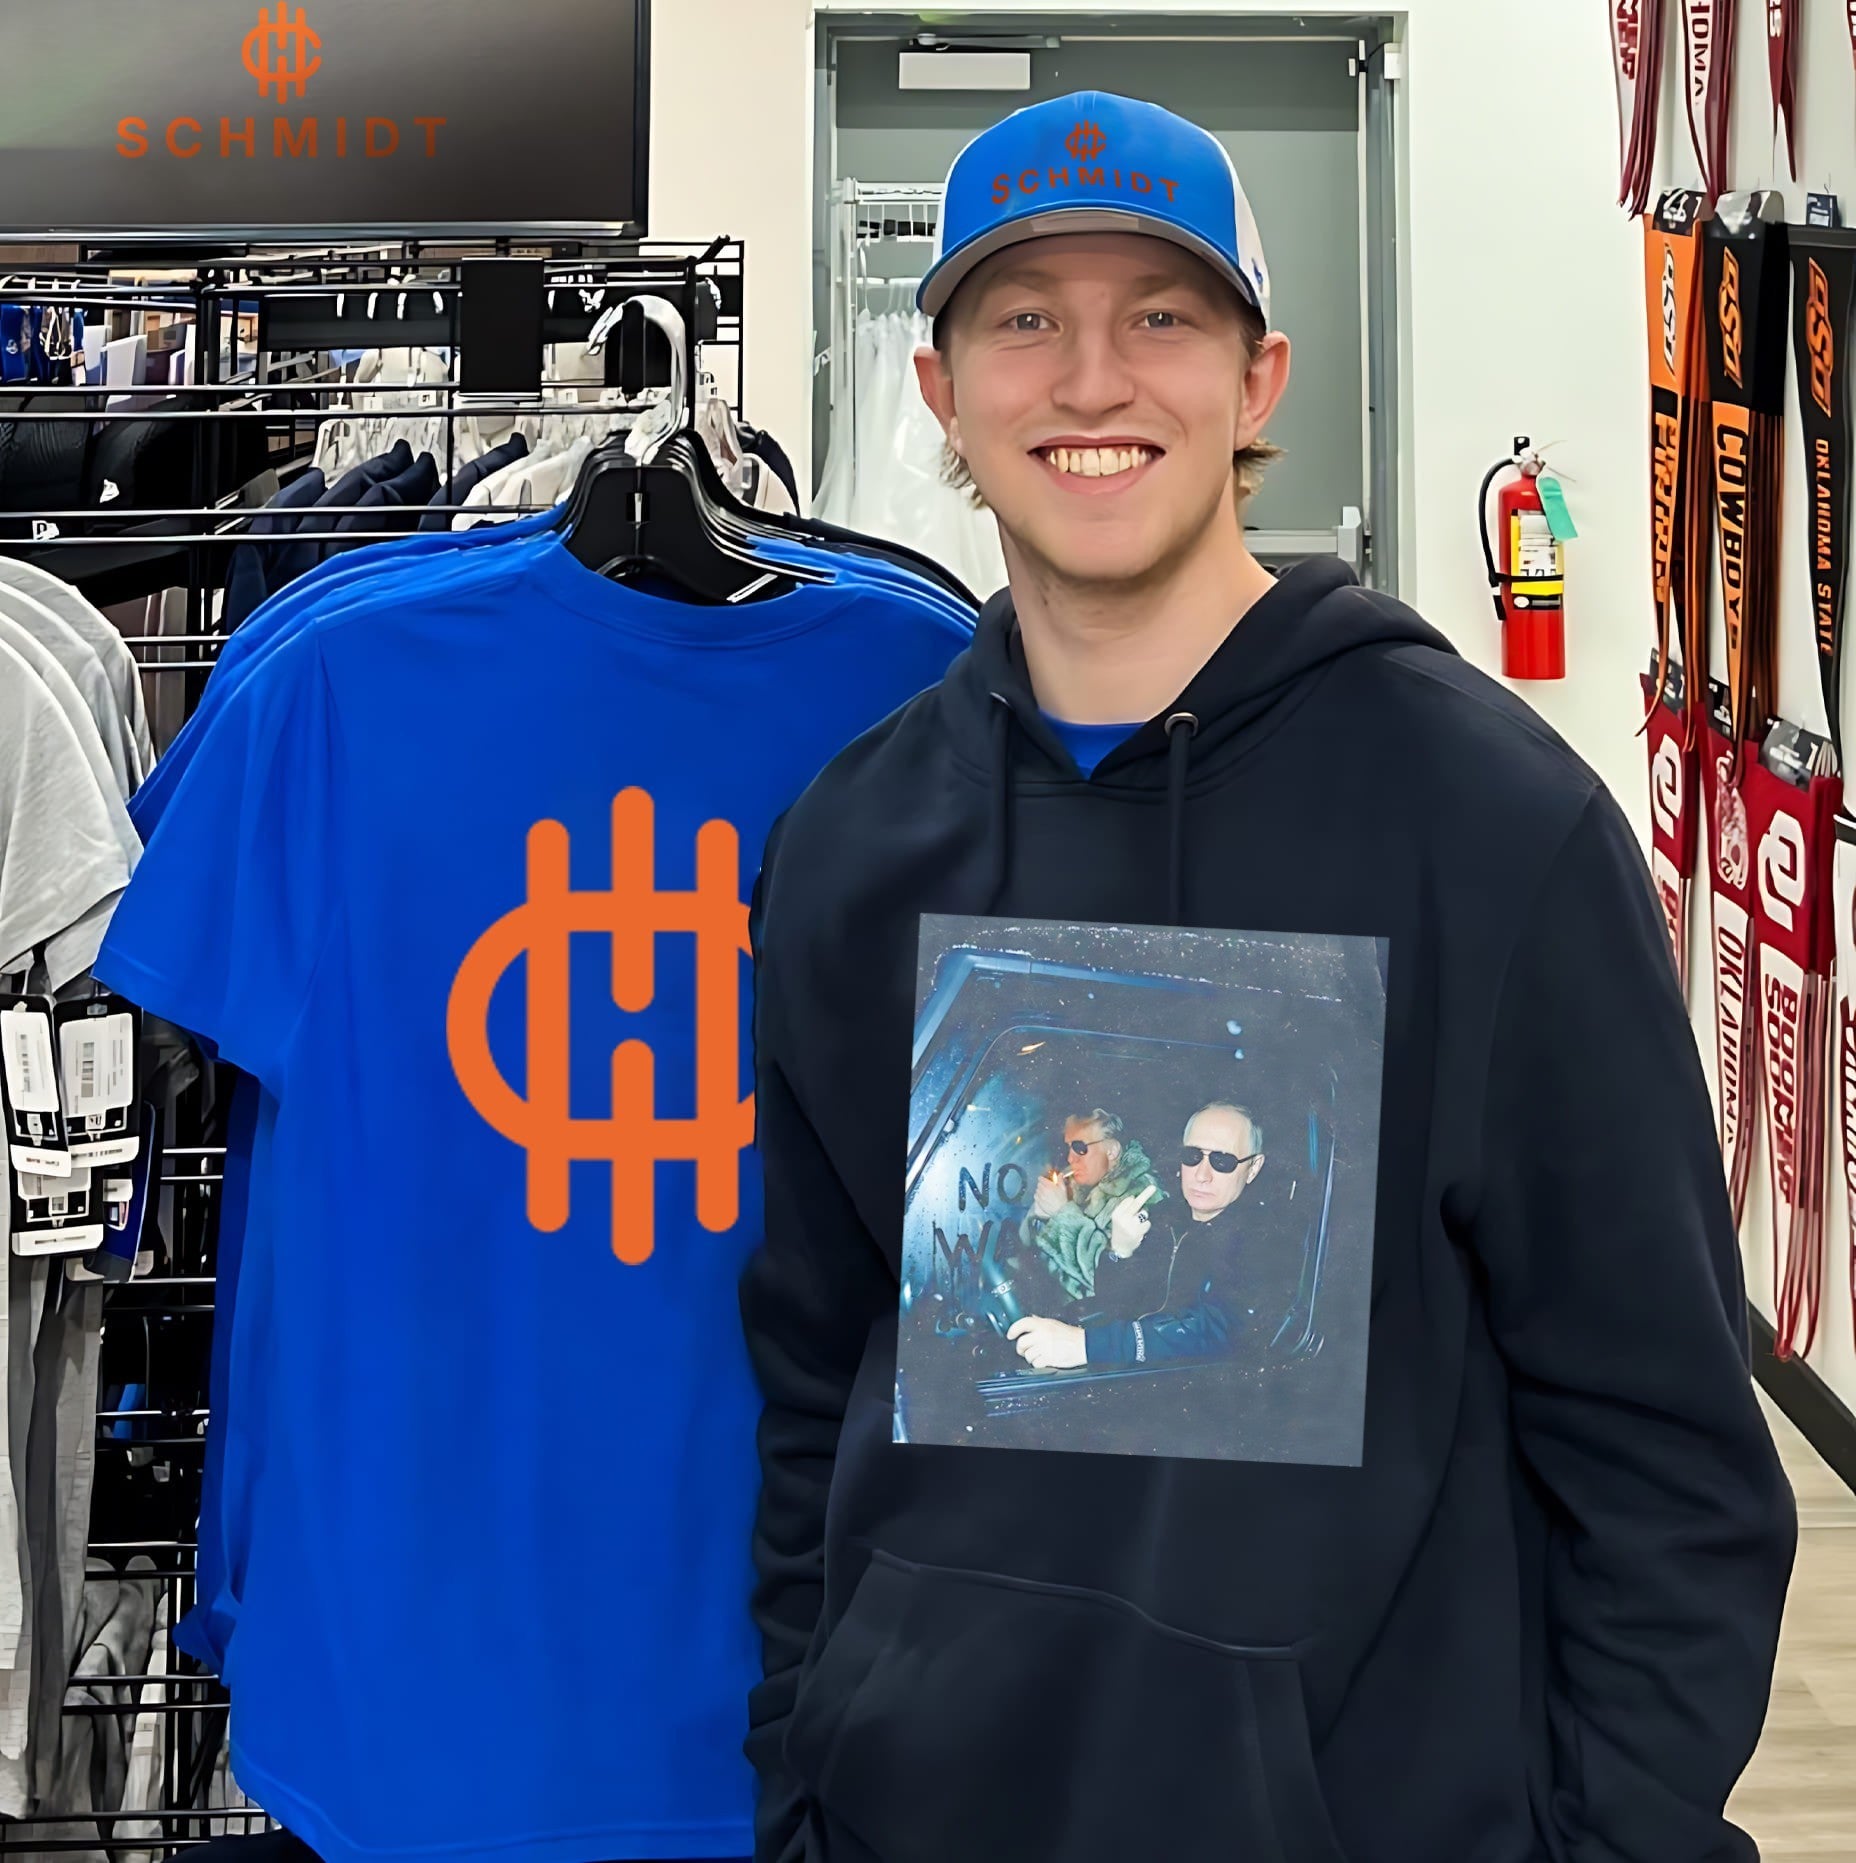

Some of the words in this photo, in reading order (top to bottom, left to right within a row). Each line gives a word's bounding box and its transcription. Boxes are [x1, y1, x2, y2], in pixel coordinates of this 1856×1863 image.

[115, 116, 448, 159] SCHMIDT
[991, 166, 1180, 205] SCHMIDT
[1815, 438, 1832, 571] OKLAHOMA
[958, 1162, 1028, 1212] NO
